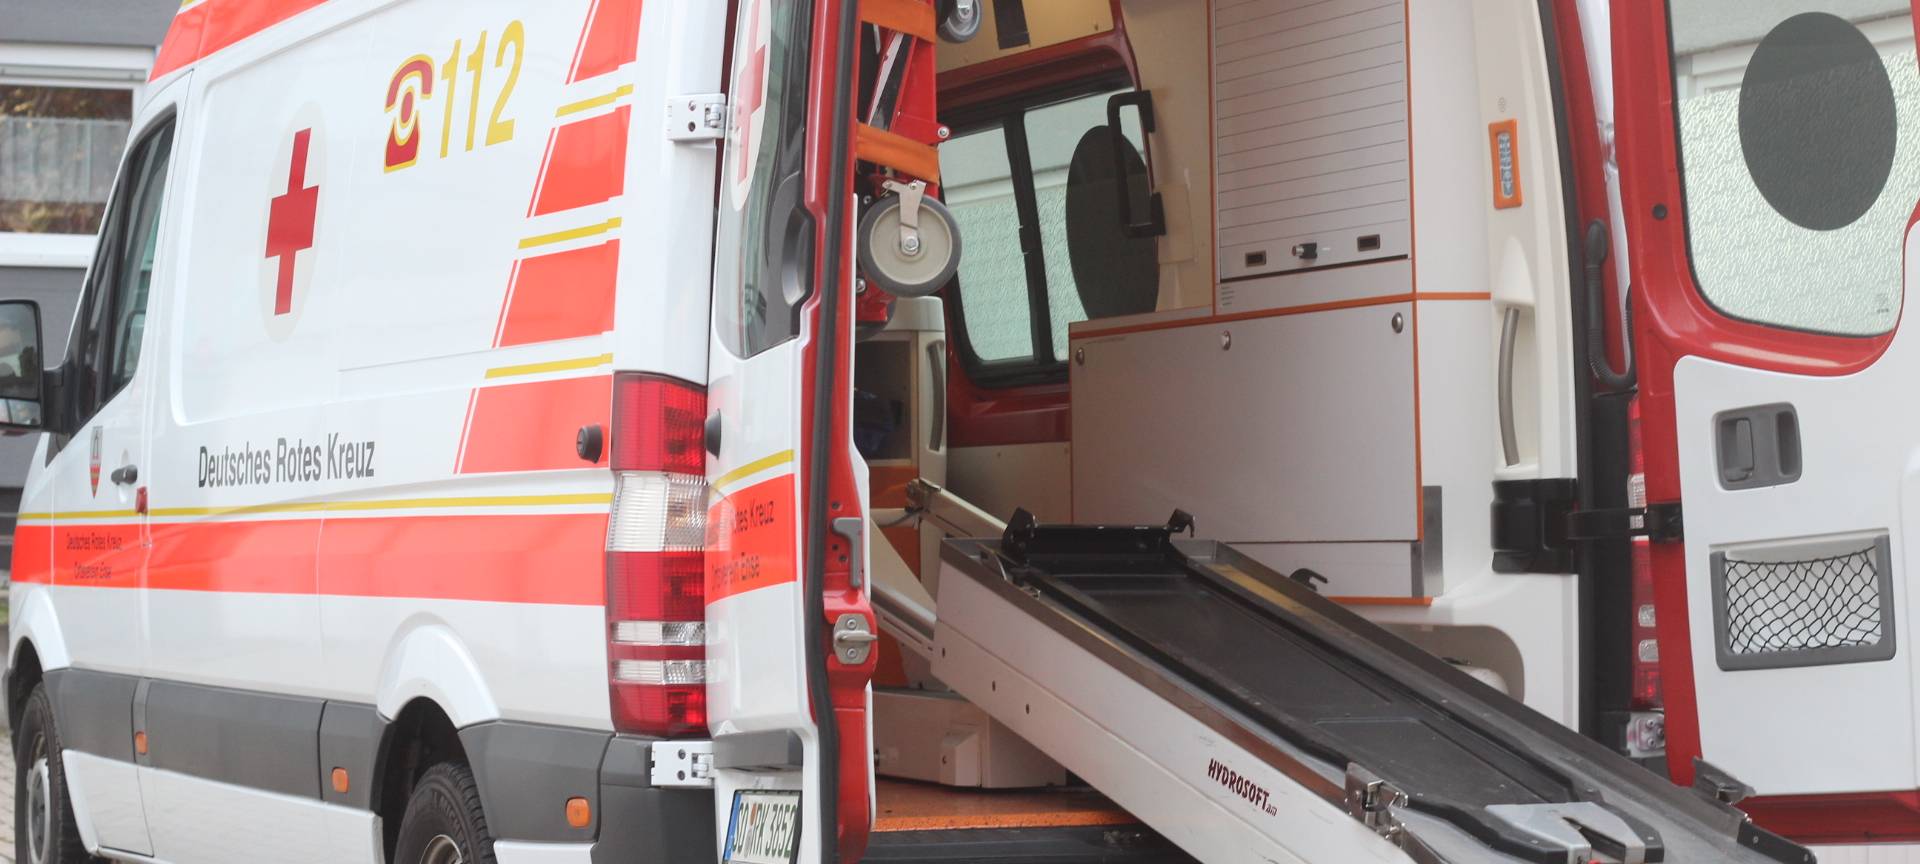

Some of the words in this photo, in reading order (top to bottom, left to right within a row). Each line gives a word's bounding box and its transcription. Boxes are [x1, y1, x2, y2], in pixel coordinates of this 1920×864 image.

[440, 20, 525, 158] 112
[198, 441, 271, 488] Deutsches
[276, 437, 321, 482] Rotes
[327, 432, 375, 480] Kreuz
[1207, 758, 1270, 811] HYDROSOFT
